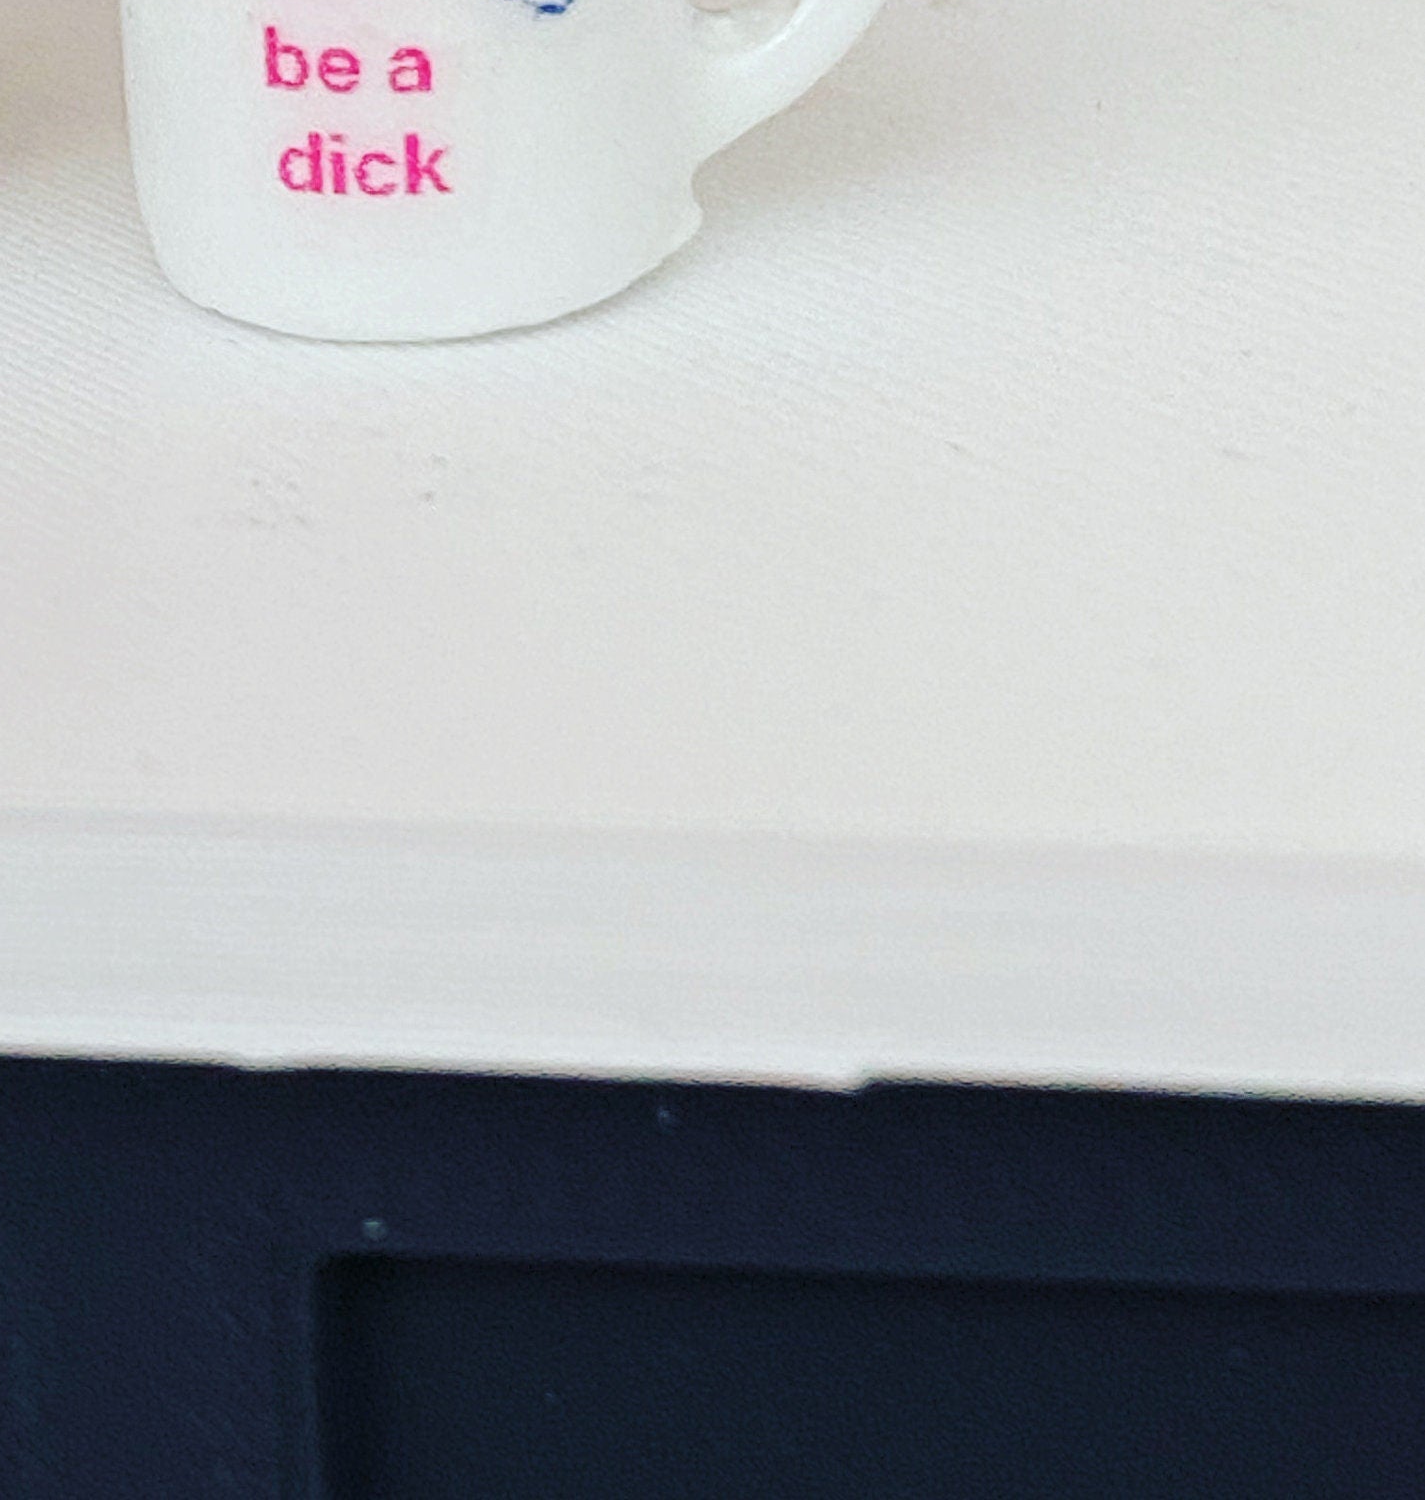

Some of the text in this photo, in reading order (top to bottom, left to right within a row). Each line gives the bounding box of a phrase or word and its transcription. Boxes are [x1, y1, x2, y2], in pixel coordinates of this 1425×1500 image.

[263, 25, 434, 94] be a
[278, 131, 452, 196] dick
